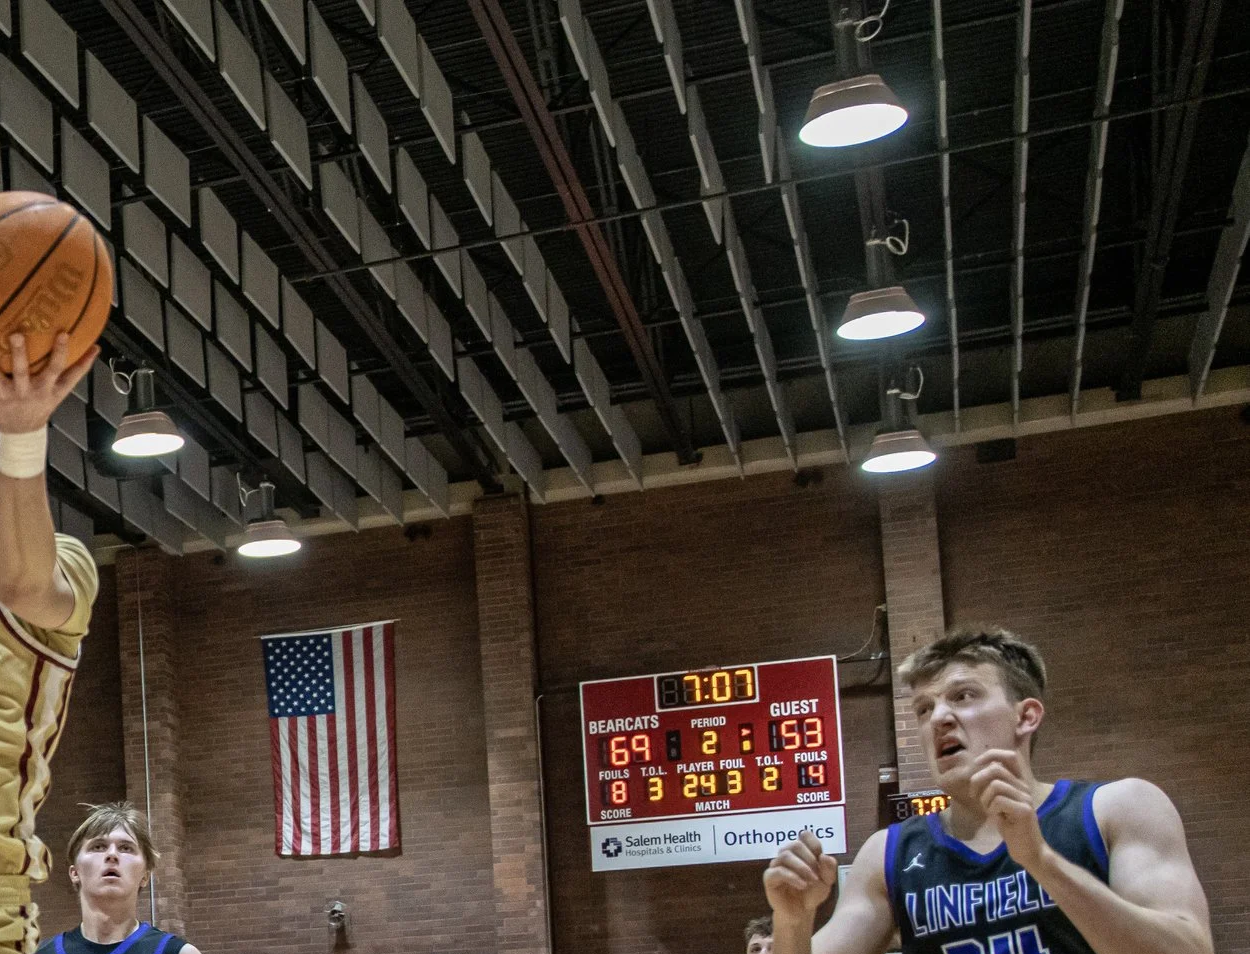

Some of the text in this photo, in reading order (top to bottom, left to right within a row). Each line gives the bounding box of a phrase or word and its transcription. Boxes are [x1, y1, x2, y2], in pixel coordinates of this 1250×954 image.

[682, 669, 753, 702] 7:07
[769, 699, 819, 717] GUEST
[588, 715, 660, 735] BEARCATS
[690, 716, 727, 728] PERIOD
[702, 730, 718, 754] 2
[780, 717, 823, 750] 53
[610, 734, 650, 766] 69
[794, 751, 828, 763] FOULS
[676, 758, 745, 773] PLAYER FOUL
[755, 755, 783, 767] T.O.L.
[598, 769, 630, 780] FOULS
[640, 766, 667, 777] T.O.L.
[762, 767, 779, 791] 2
[808, 764, 824, 785] 4
[649, 777, 663, 800] 3
[683, 774, 716, 798] 24
[727, 770, 742, 794] 3
[611, 781, 627, 804] 8
[796, 791, 830, 803] SCORE
[600, 808, 631, 820] SCORE
[695, 800, 730, 811] MATCH
[911, 796, 951, 816] 7:0
[625, 831, 701, 847] Salem Health
[625, 847, 664, 857] Hospitals
[674, 844, 702, 853] Clinics
